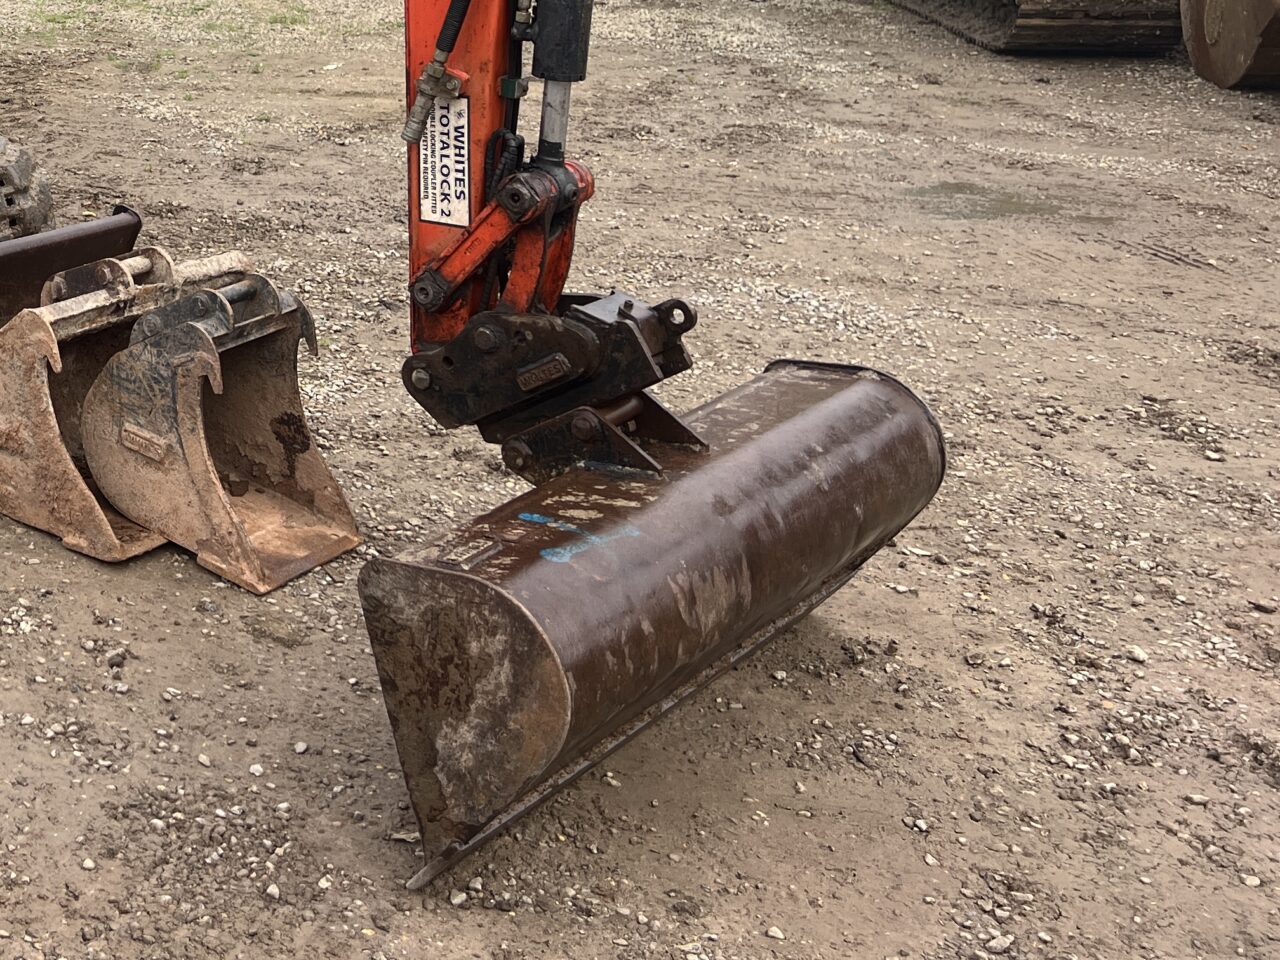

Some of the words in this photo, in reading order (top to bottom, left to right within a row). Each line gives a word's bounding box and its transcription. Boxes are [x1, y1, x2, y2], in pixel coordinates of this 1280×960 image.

[439, 103, 451, 205] TOTALOCK
[453, 125, 466, 201] WHITES
[440, 208, 452, 217] 2
